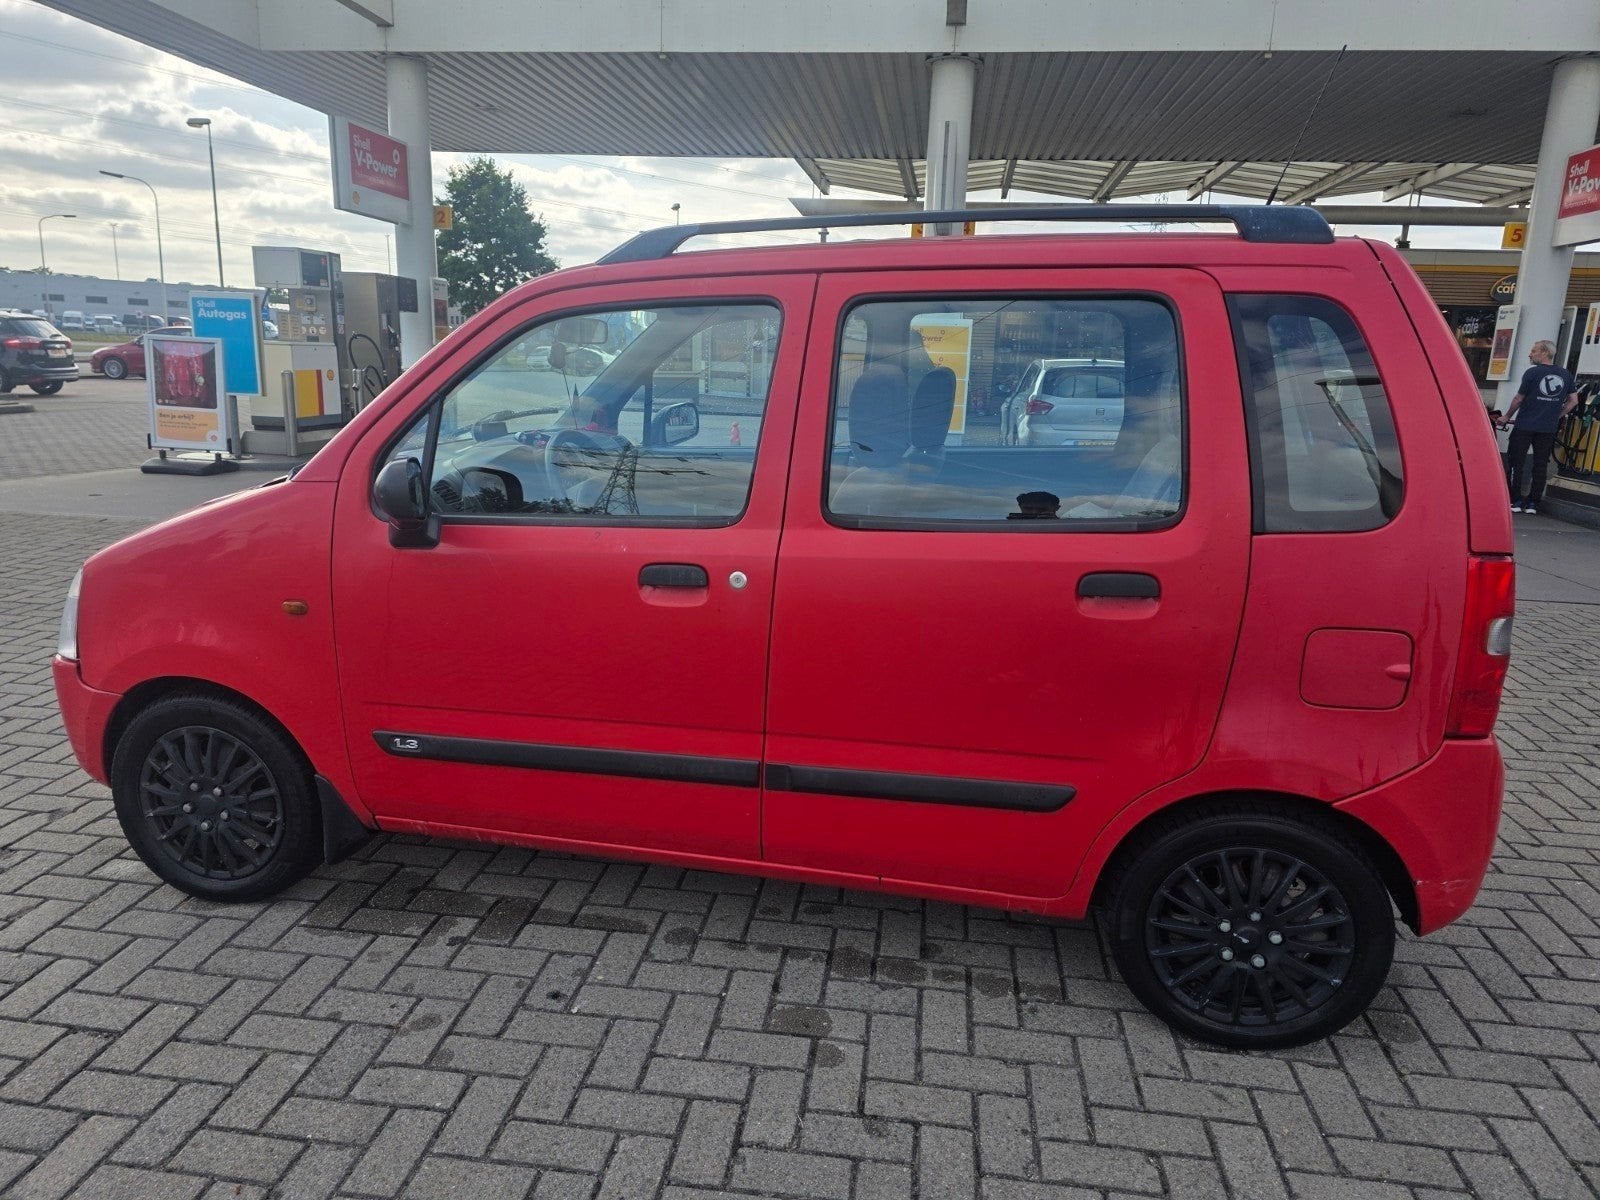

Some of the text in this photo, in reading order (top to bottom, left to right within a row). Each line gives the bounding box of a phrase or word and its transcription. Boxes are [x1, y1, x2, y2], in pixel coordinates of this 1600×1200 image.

[353, 134, 371, 150] Shell
[354, 148, 398, 178] V-Power
[1570, 160, 1590, 178] Shell
[437, 211, 445, 223] 2
[1511, 229, 1523, 242] 5
[1496, 282, 1516, 294] caf
[196, 300, 216, 308] Shell
[198, 308, 247, 321] Autogas
[1462, 317, 1479, 334] café
[393, 738, 418, 749] 1.3
